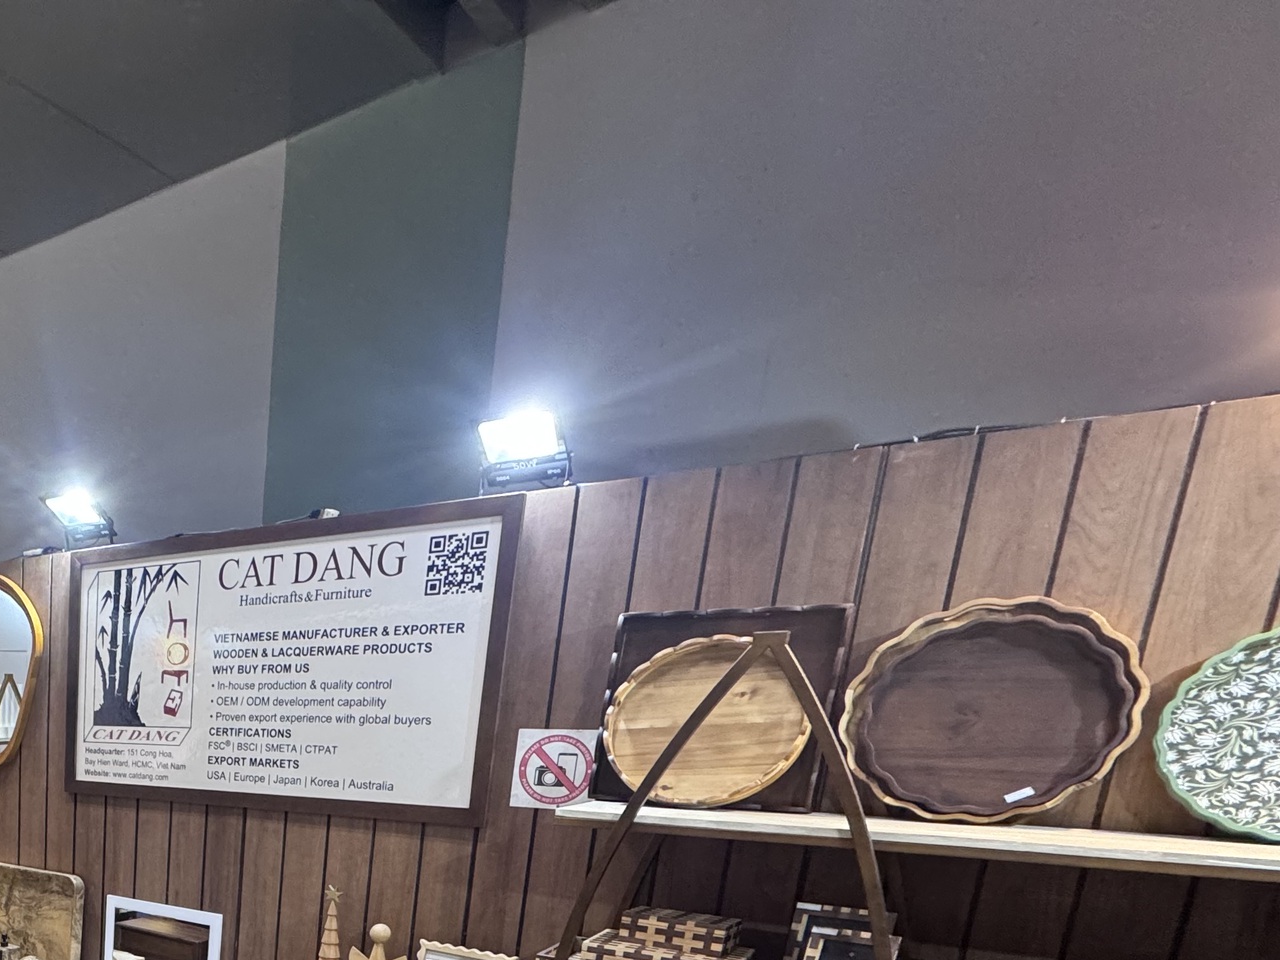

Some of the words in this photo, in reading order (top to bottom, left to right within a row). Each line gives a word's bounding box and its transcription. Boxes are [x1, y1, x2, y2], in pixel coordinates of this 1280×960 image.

[219, 554, 284, 590] CAT
[291, 541, 407, 585] DANG
[214, 630, 279, 644] VIETNAMESE
[282, 626, 378, 641] MANUFACTURER
[381, 626, 390, 638] &
[393, 622, 465, 636] EXPORTER
[213, 648, 258, 660] WOODEN
[261, 648, 268, 658] &
[271, 644, 360, 658] LACQUERWARE
[363, 642, 433, 654] PRODUCTS
[212, 664, 235, 675] WHY
[237, 664, 258, 674] BUY
[261, 664, 292, 674] FROM
[295, 663, 310, 674] US
[217, 681, 256, 691] In-house
[258, 680, 307, 692] production
[310, 680, 317, 690] &
[320, 680, 353, 692] quality
[356, 679, 392, 690] control
[216, 696, 239, 706] OEM
[246, 696, 270, 706] ODM
[272, 697, 335, 709] development
[337, 697, 387, 709] capability
[216, 712, 246, 722] Proven
[248, 713, 278, 724] export
[279, 713, 332, 725] experience
[335, 714, 356, 724] with
[358, 714, 392, 726] global
[394, 715, 432, 726] buyers
[92, 728, 127, 740] CAT
[128, 730, 180, 742] DANG
[208, 727, 292, 739] CERTIFICATIONS
[84, 747, 126, 756] Headquarter:
[127, 748, 138, 756] 151
[140, 748, 157, 759] Cong
[236, 742, 258, 752] BSCI
[265, 742, 298, 754] SMETA
[304, 744, 338, 755] CTPAT
[525, 743, 540, 759] PLEASE
[563, 736, 576, 744] TAKE
[576, 742, 591, 760] PHOTOS
[84, 758, 96, 766] Bay
[156, 761, 169, 770] Viet
[170, 762, 186, 770] Nam
[208, 756, 247, 767] EXPORT
[249, 757, 300, 770] MARKETS
[84, 768, 112, 778] Website:
[206, 770, 226, 781] USA
[233, 772, 266, 784] Europe
[273, 774, 302, 786] Japan
[310, 776, 340, 788] Korea
[348, 778, 394, 792] Australia
[568, 782, 587, 798] PHOTOS
